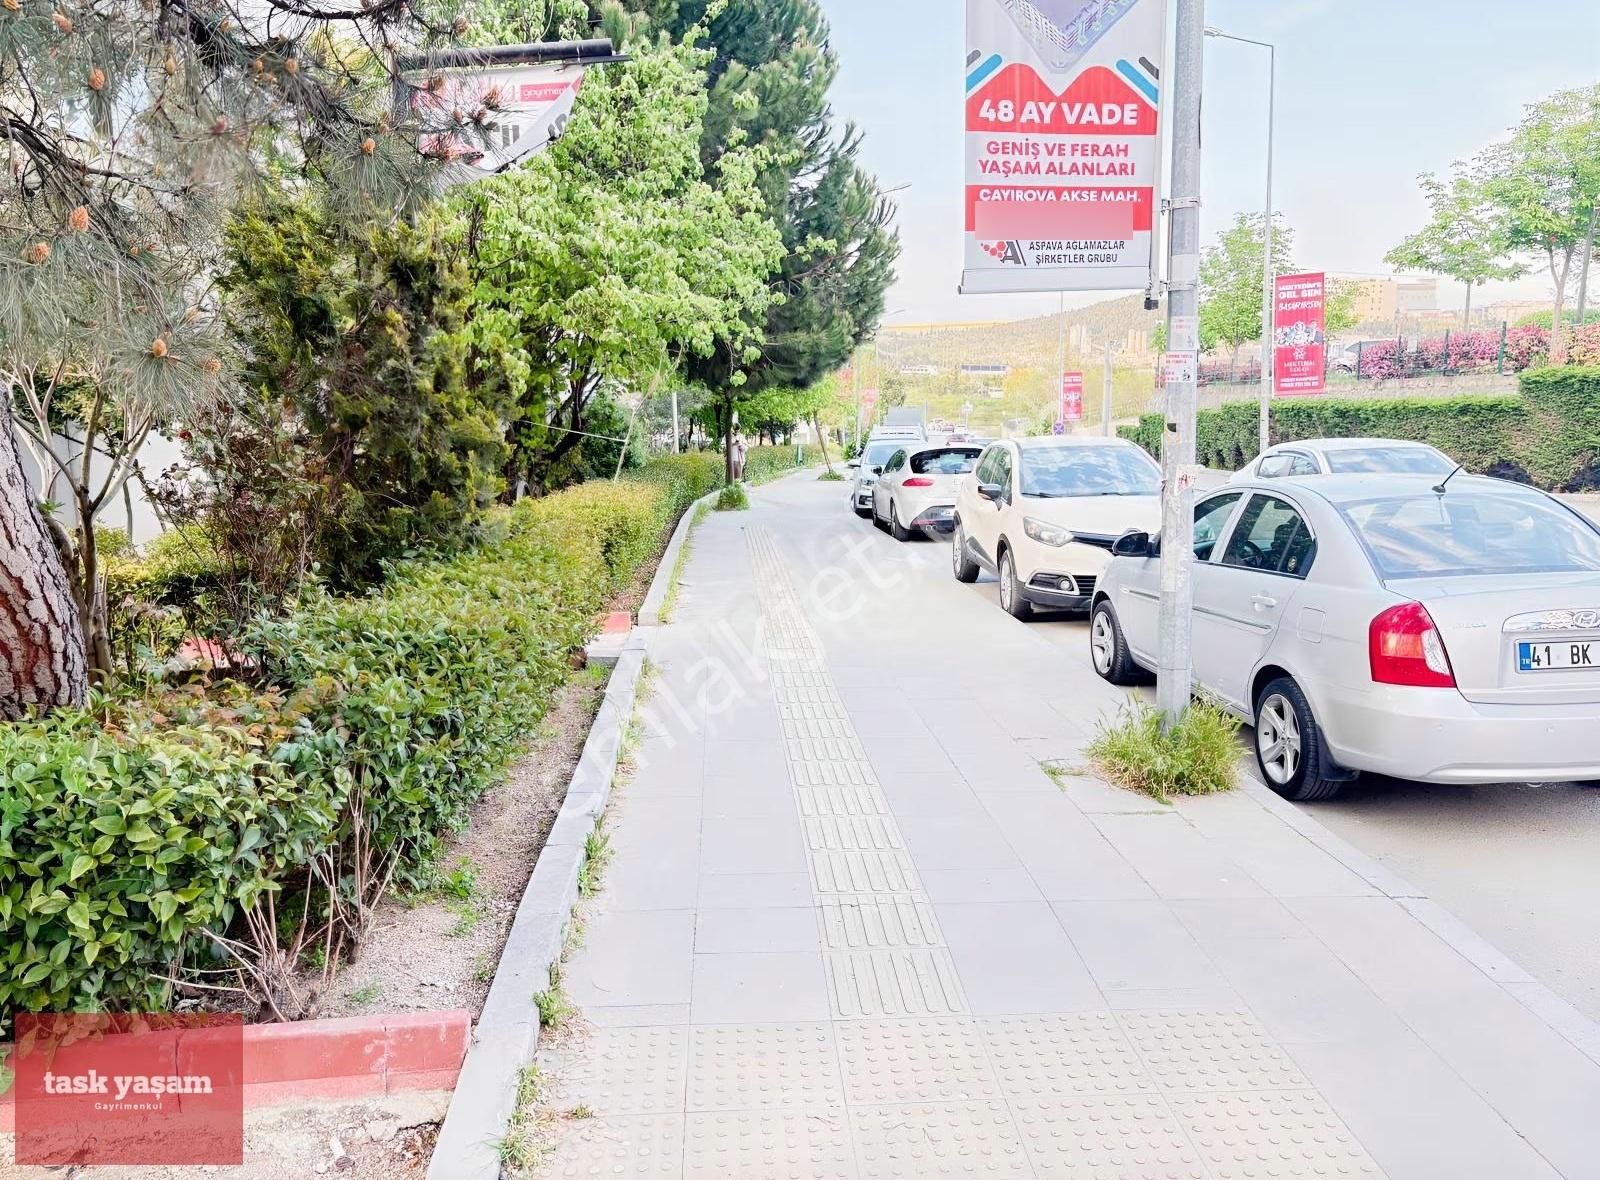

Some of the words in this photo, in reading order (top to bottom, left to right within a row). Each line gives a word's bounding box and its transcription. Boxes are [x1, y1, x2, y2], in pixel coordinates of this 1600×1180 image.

[978, 98, 1015, 122] 48
[1020, 101, 1057, 123] AY
[1062, 103, 1138, 124] VADE
[986, 138, 1040, 158] GENİŞ
[1044, 143, 1066, 157] VE
[1071, 143, 1129, 158] FERAH
[978, 160, 1041, 178] YAŞAM
[1045, 161, 1136, 177] ALANLARI
[1060, 190, 1098, 202] AKSE
[1101, 191, 1142, 203] MAH.
[1029, 241, 1064, 251] ASPAVA
[1035, 253, 1085, 265] ŞİRKETLER
[1087, 253, 1118, 263] GRUBU
[1532, 645, 1552, 667] 41
[1570, 643, 1592, 665] BK
